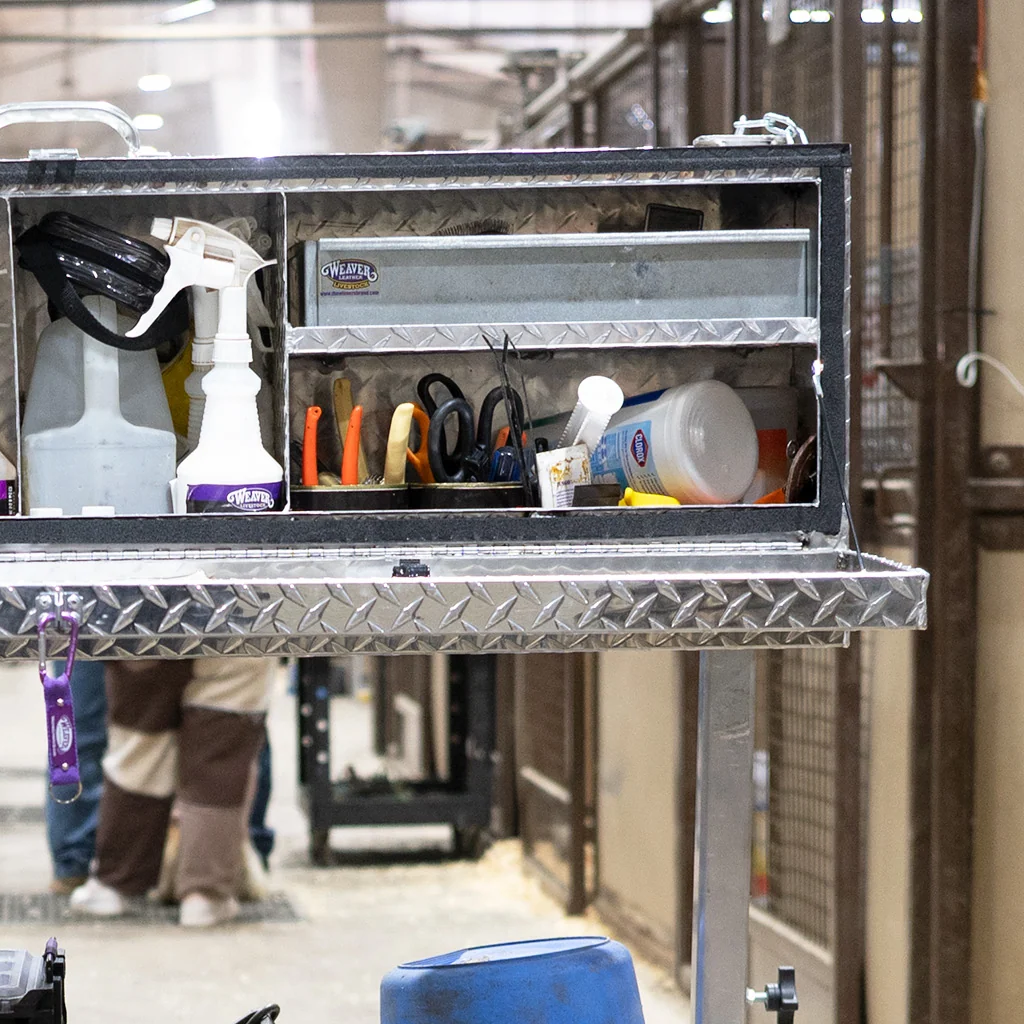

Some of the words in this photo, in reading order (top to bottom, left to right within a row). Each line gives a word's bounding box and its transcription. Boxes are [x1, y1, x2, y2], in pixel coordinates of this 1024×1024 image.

[321, 260, 378, 282] WEAVER
[635, 433, 645, 463] CLOROX
[227, 487, 275, 508] WEAVER
